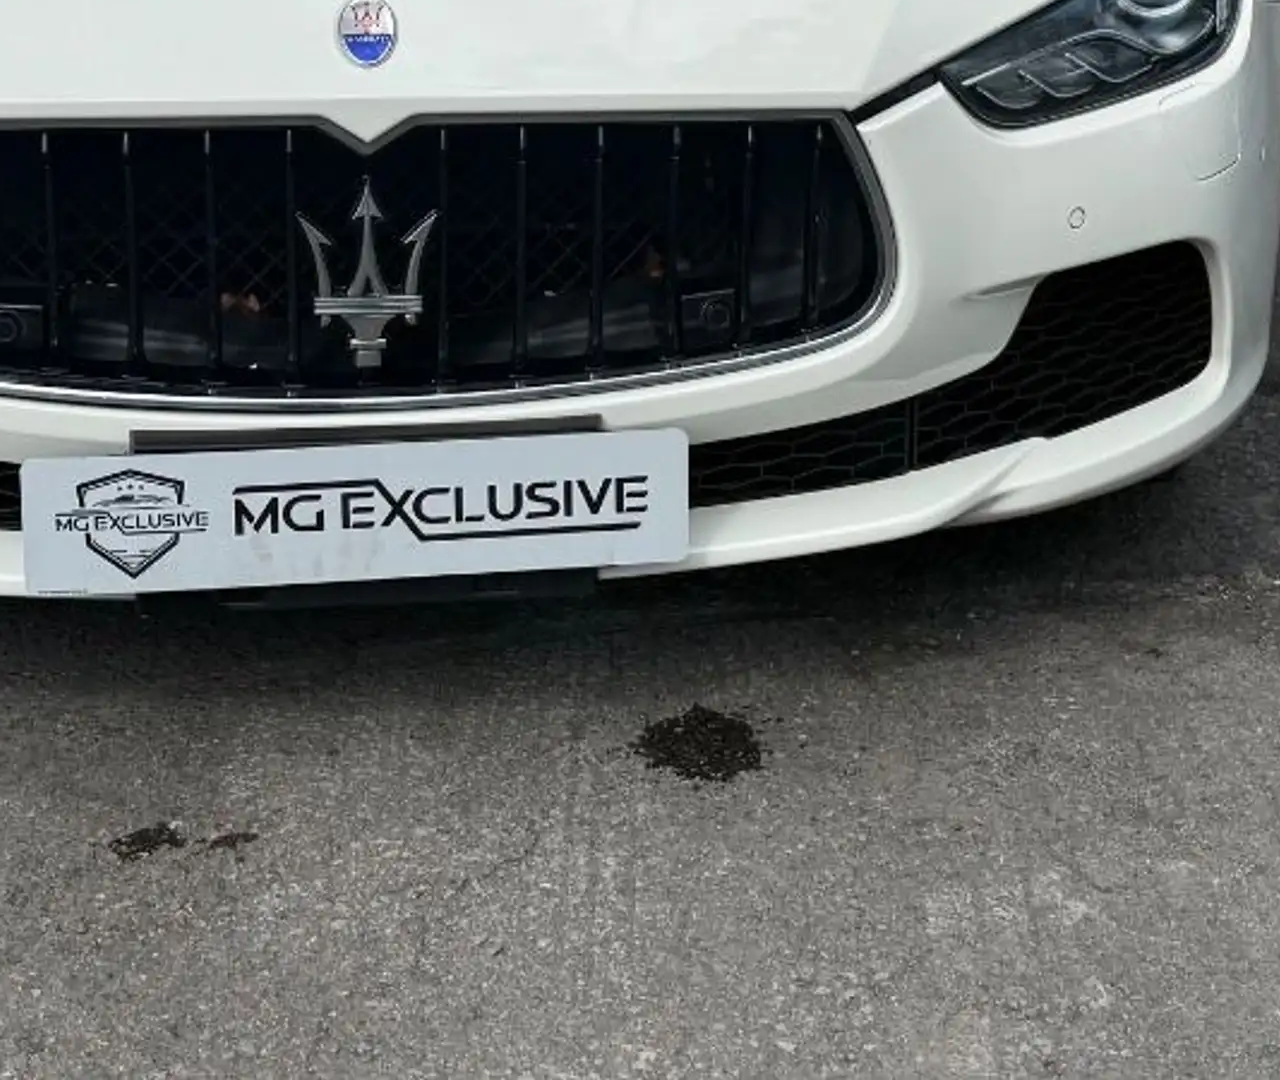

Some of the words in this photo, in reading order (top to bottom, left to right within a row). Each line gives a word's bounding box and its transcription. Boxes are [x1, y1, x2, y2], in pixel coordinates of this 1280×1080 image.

[55, 515, 89, 532] MG
[95, 511, 209, 531] EXCLUSIVE
[233, 493, 324, 536] MG
[340, 475, 649, 532] EXCLUSIVE
